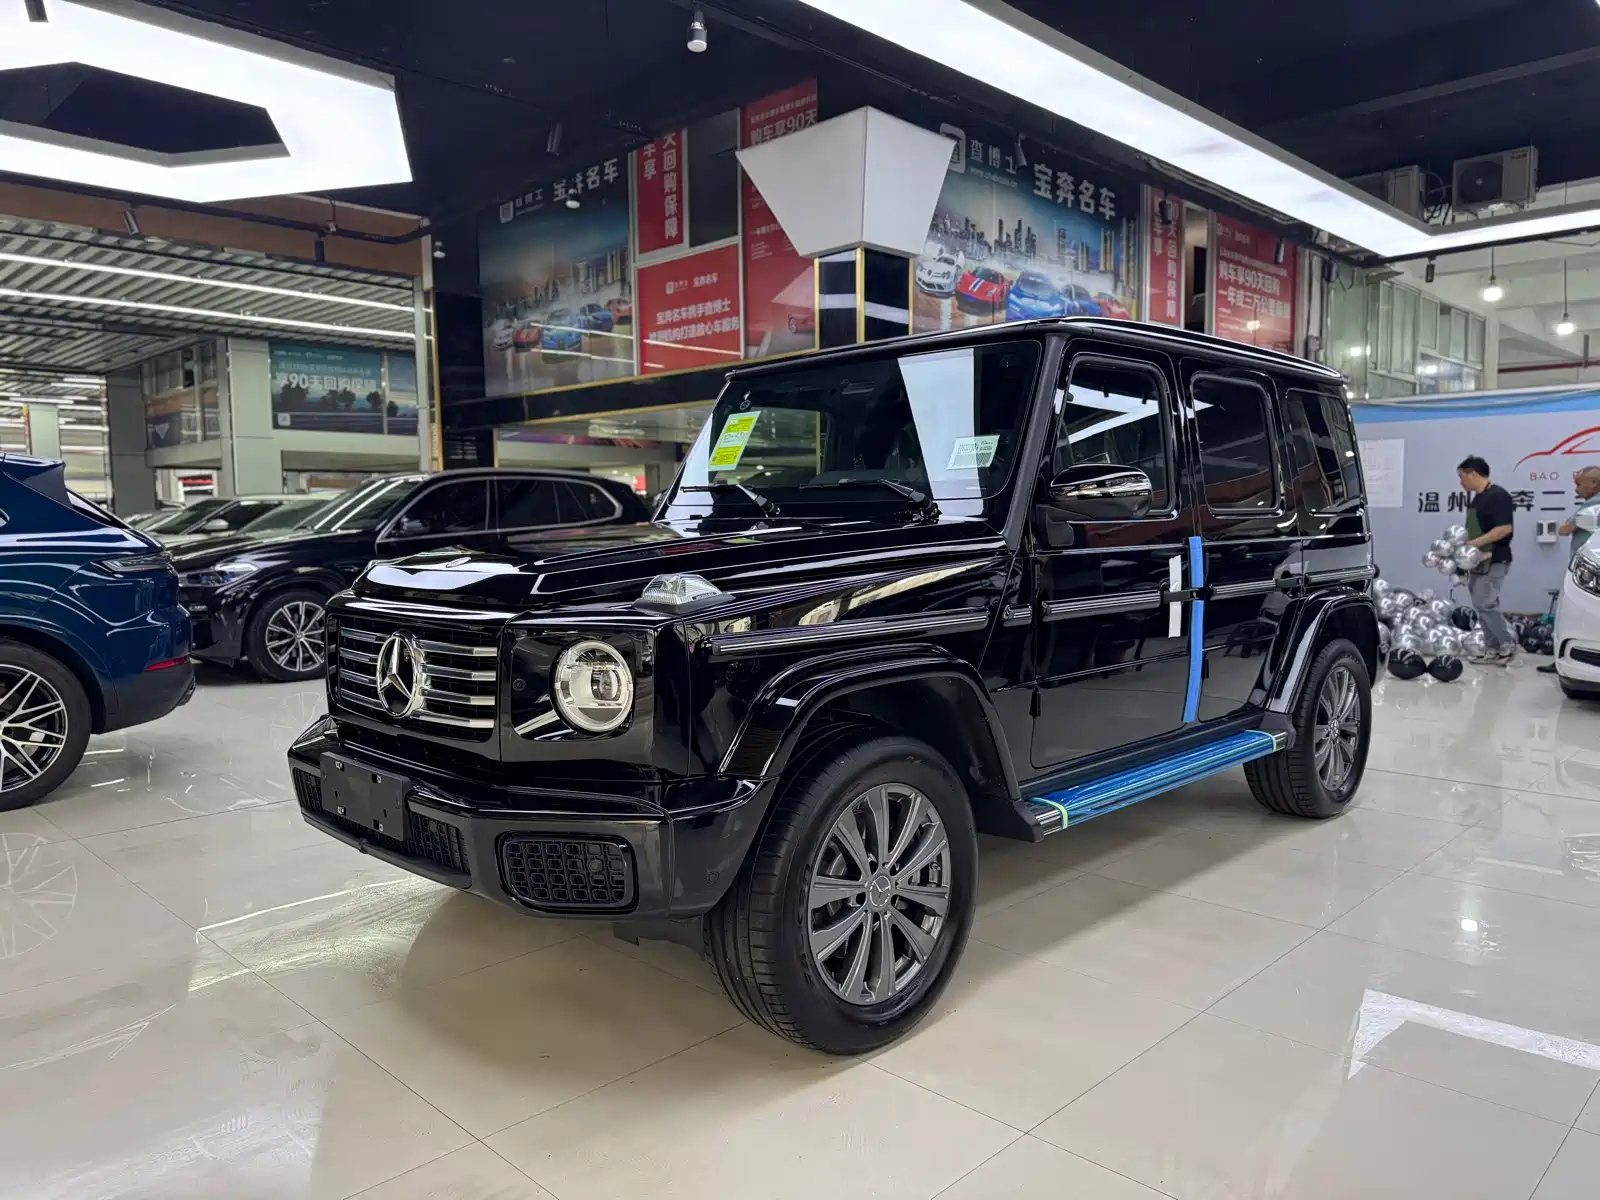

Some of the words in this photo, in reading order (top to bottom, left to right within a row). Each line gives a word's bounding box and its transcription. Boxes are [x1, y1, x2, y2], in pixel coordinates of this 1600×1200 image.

[1033, 163, 1117, 221] 宝奔名车
[1529, 471, 1560, 481] BAO
